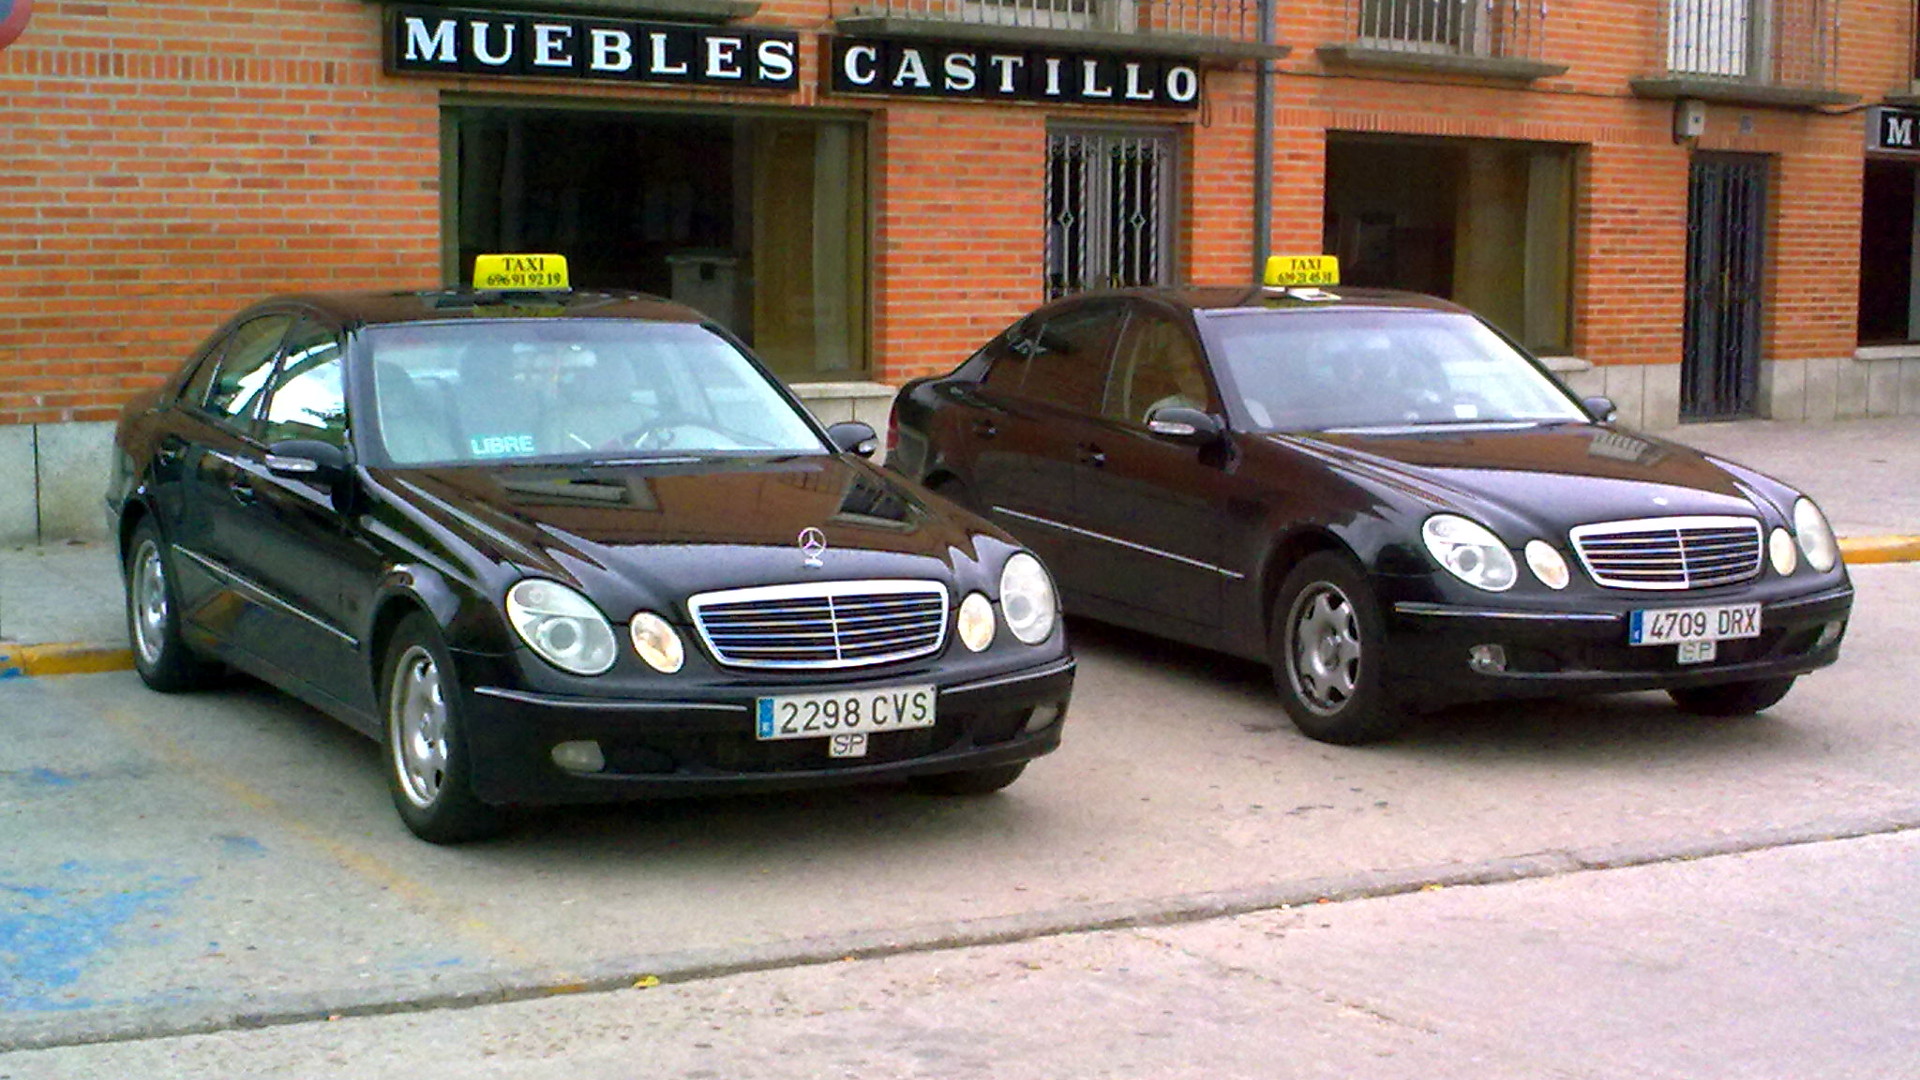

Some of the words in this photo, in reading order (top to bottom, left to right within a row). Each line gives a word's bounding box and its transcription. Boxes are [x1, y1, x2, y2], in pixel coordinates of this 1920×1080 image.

[405, 17, 795, 80] MUEBLES
[843, 45, 1198, 102] CASTILLO
[1886, 116, 1920, 146] M
[502, 257, 545, 271] TAXI
[1289, 258, 1322, 271] TAXI
[470, 435, 535, 455] LIBRE
[1649, 610, 1708, 640] 4709
[1717, 607, 1757, 636] DRX
[780, 697, 861, 735] 2298
[871, 691, 928, 726] CVS
[832, 733, 865, 756] SP
